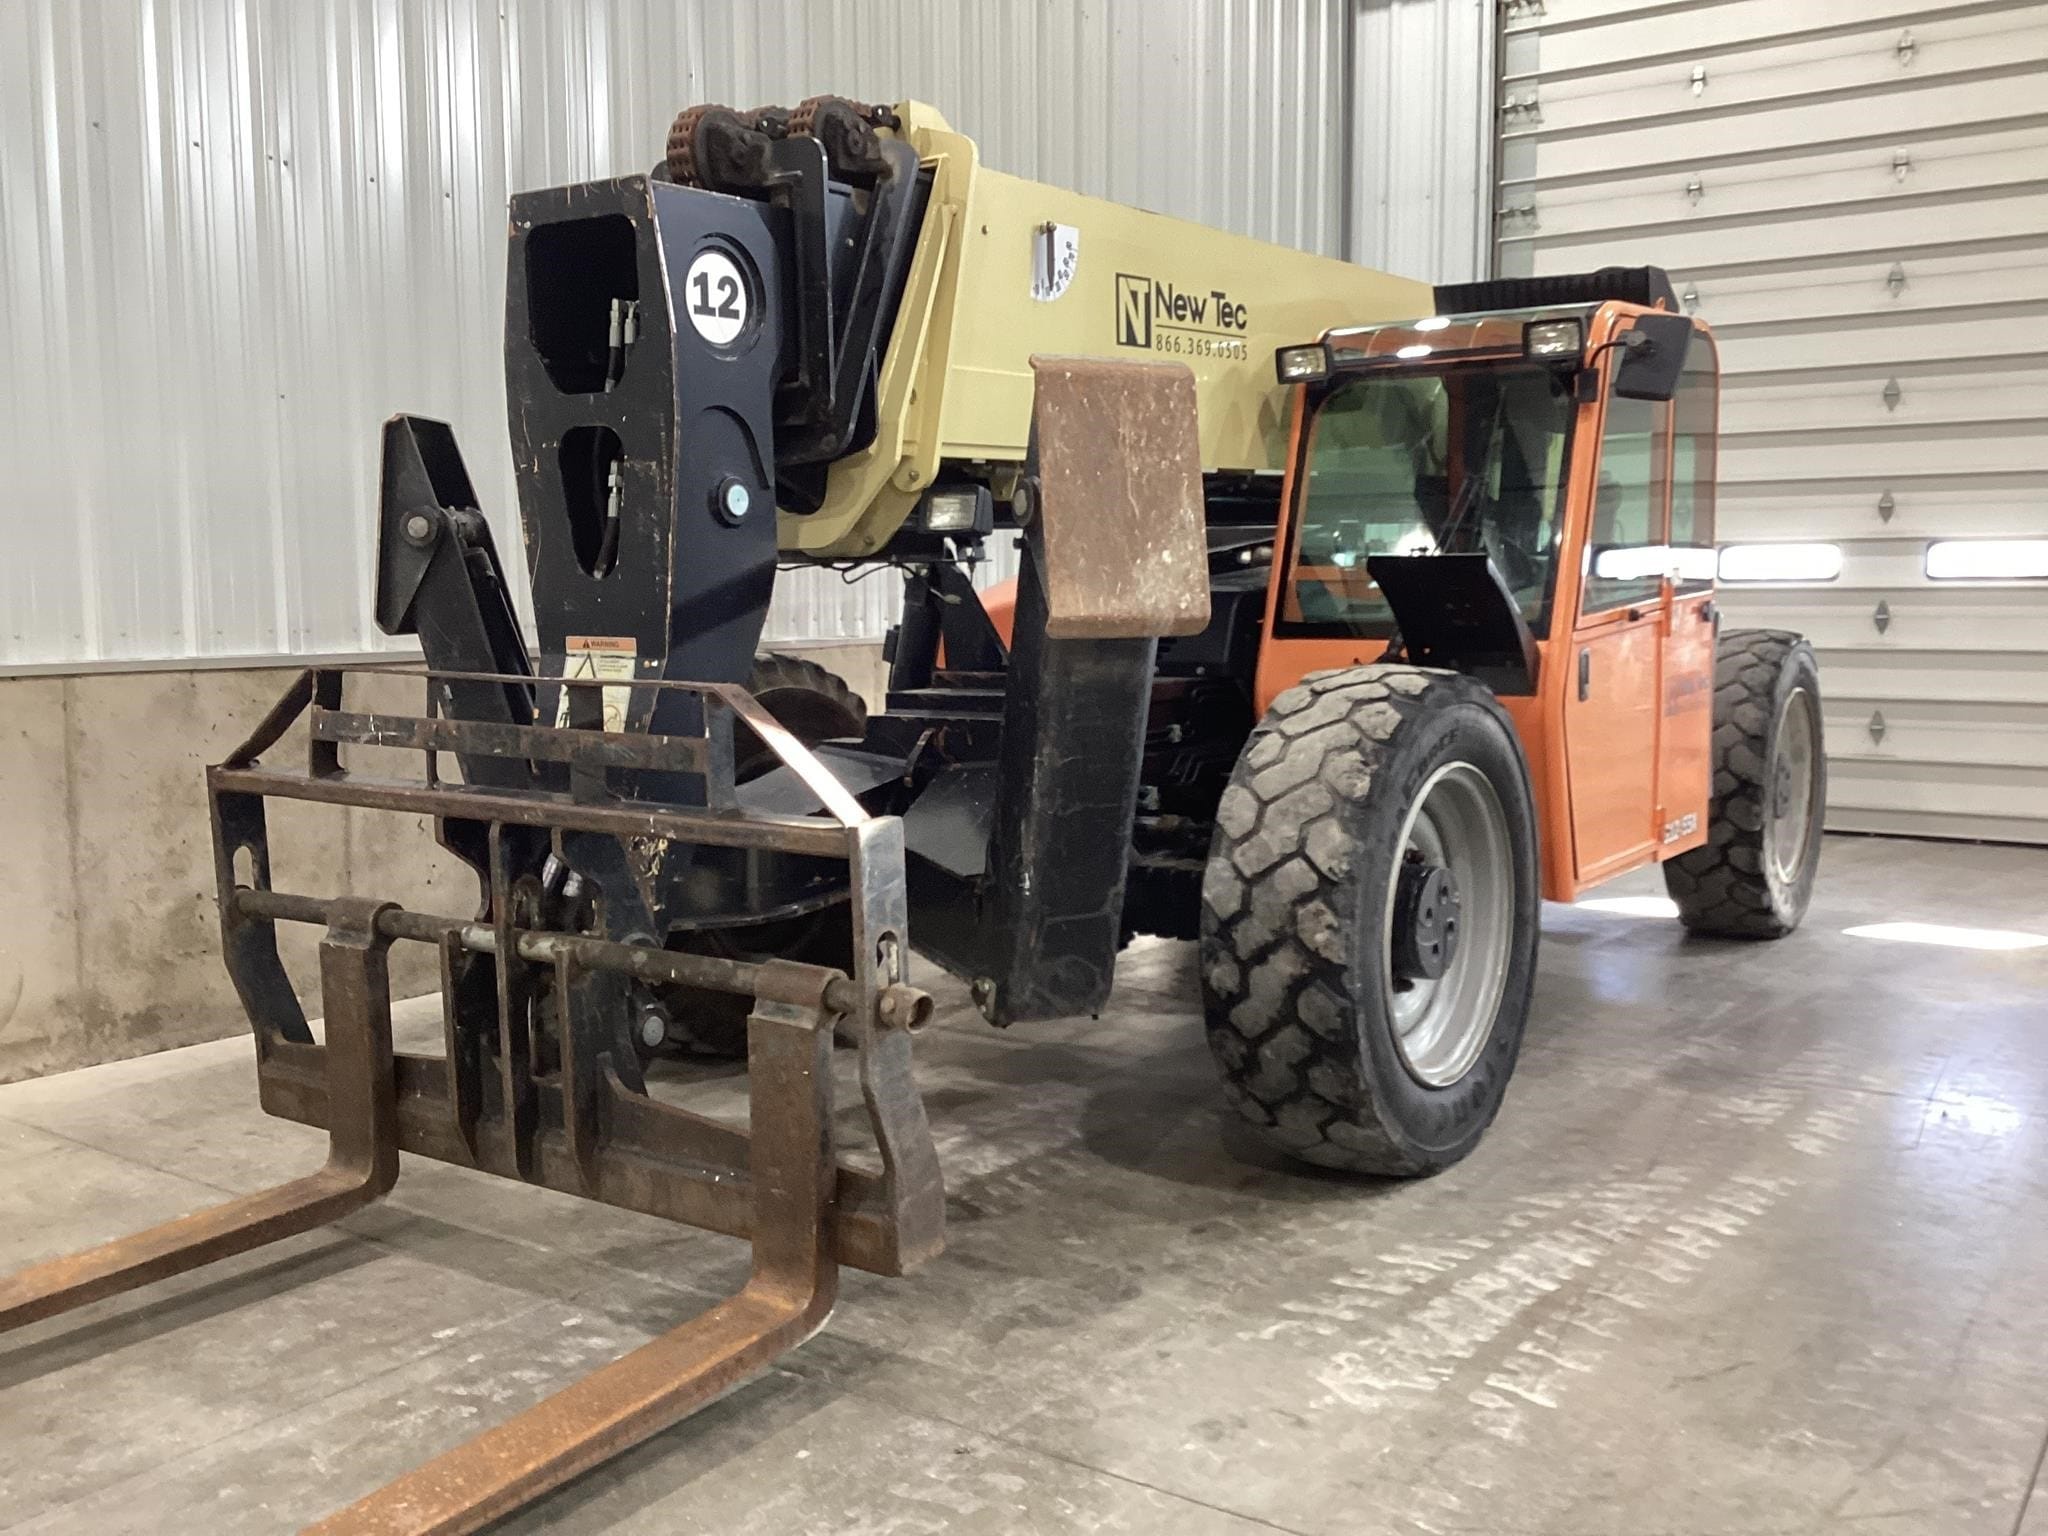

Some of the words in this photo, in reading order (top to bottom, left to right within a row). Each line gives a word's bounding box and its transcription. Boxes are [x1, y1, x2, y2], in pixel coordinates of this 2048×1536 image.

[693, 271, 740, 320] 12
[1155, 281, 1207, 324] New
[1211, 290, 1248, 330] Tec
[1156, 334, 1248, 361] 866.369.0505
[591, 640, 620, 649] WARNING
